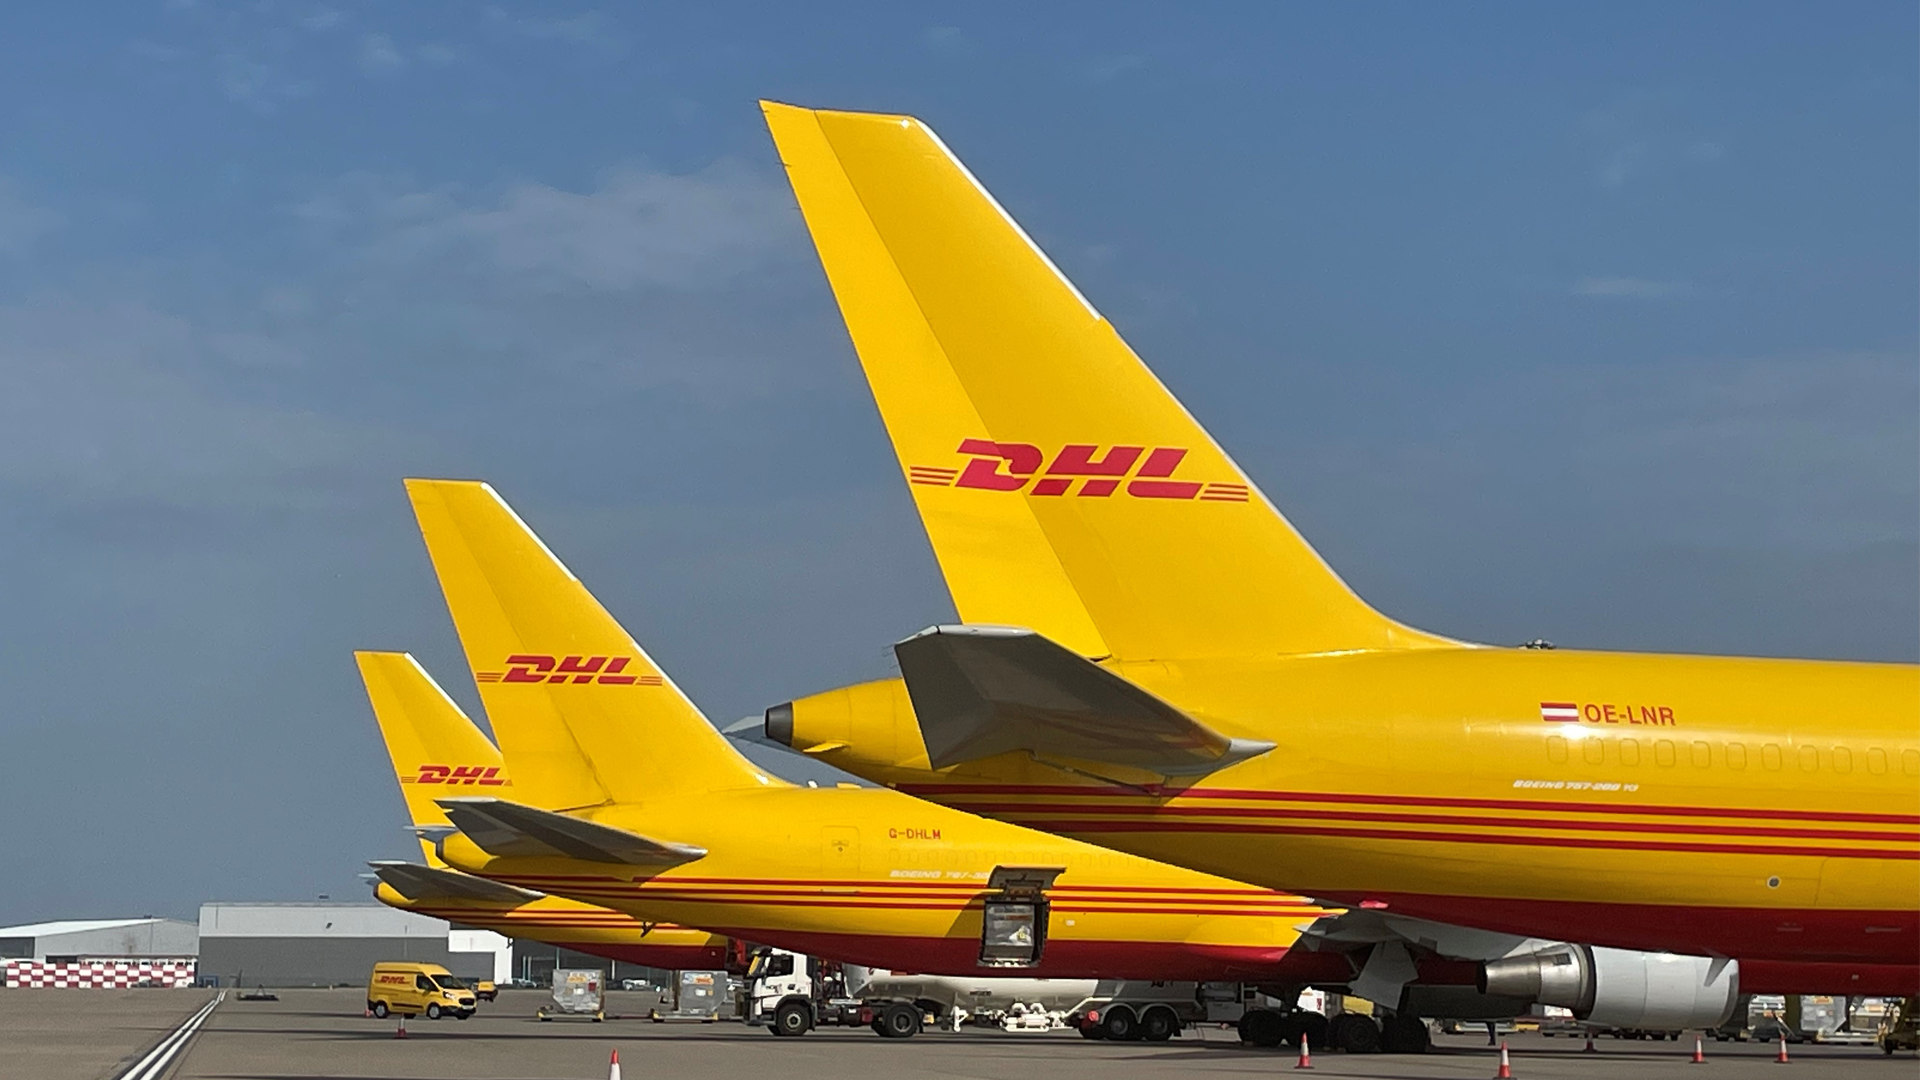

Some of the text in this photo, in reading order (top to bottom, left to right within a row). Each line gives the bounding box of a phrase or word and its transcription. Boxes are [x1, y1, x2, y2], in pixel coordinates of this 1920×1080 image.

[954, 438, 1203, 500] DHL
[502, 655, 638, 685] DHL
[1584, 703, 1676, 726] OE-LNR
[416, 765, 505, 786] DHL
[1512, 779, 1565, 789] BOEING
[889, 828, 941, 840] G-DHLM
[889, 870, 942, 878] BOEING
